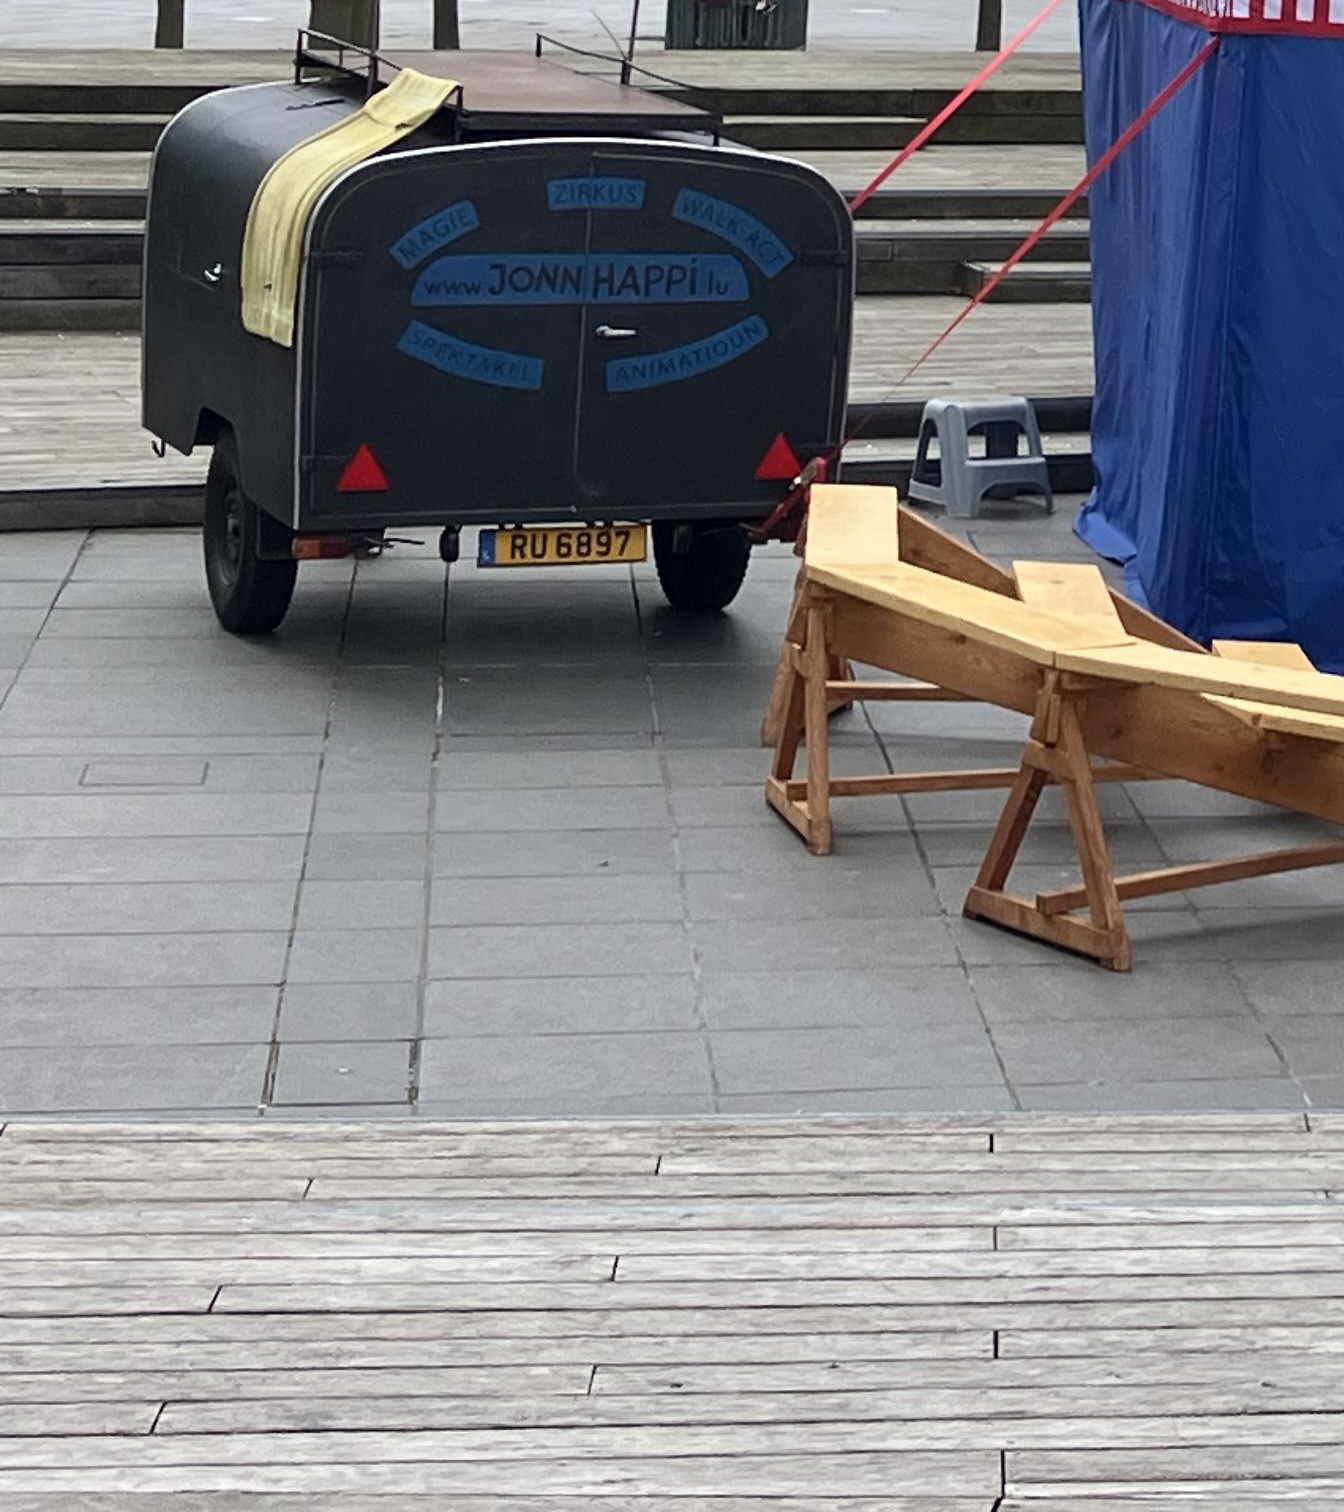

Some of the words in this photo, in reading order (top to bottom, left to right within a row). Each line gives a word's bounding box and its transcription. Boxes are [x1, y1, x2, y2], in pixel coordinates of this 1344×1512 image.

[554, 183, 638, 205] ZIRKUS
[398, 205, 475, 262] MAGIE
[615, 320, 760, 381] ANIMATIOUN
[510, 533, 549, 560] RU
[556, 530, 632, 559] 6897
